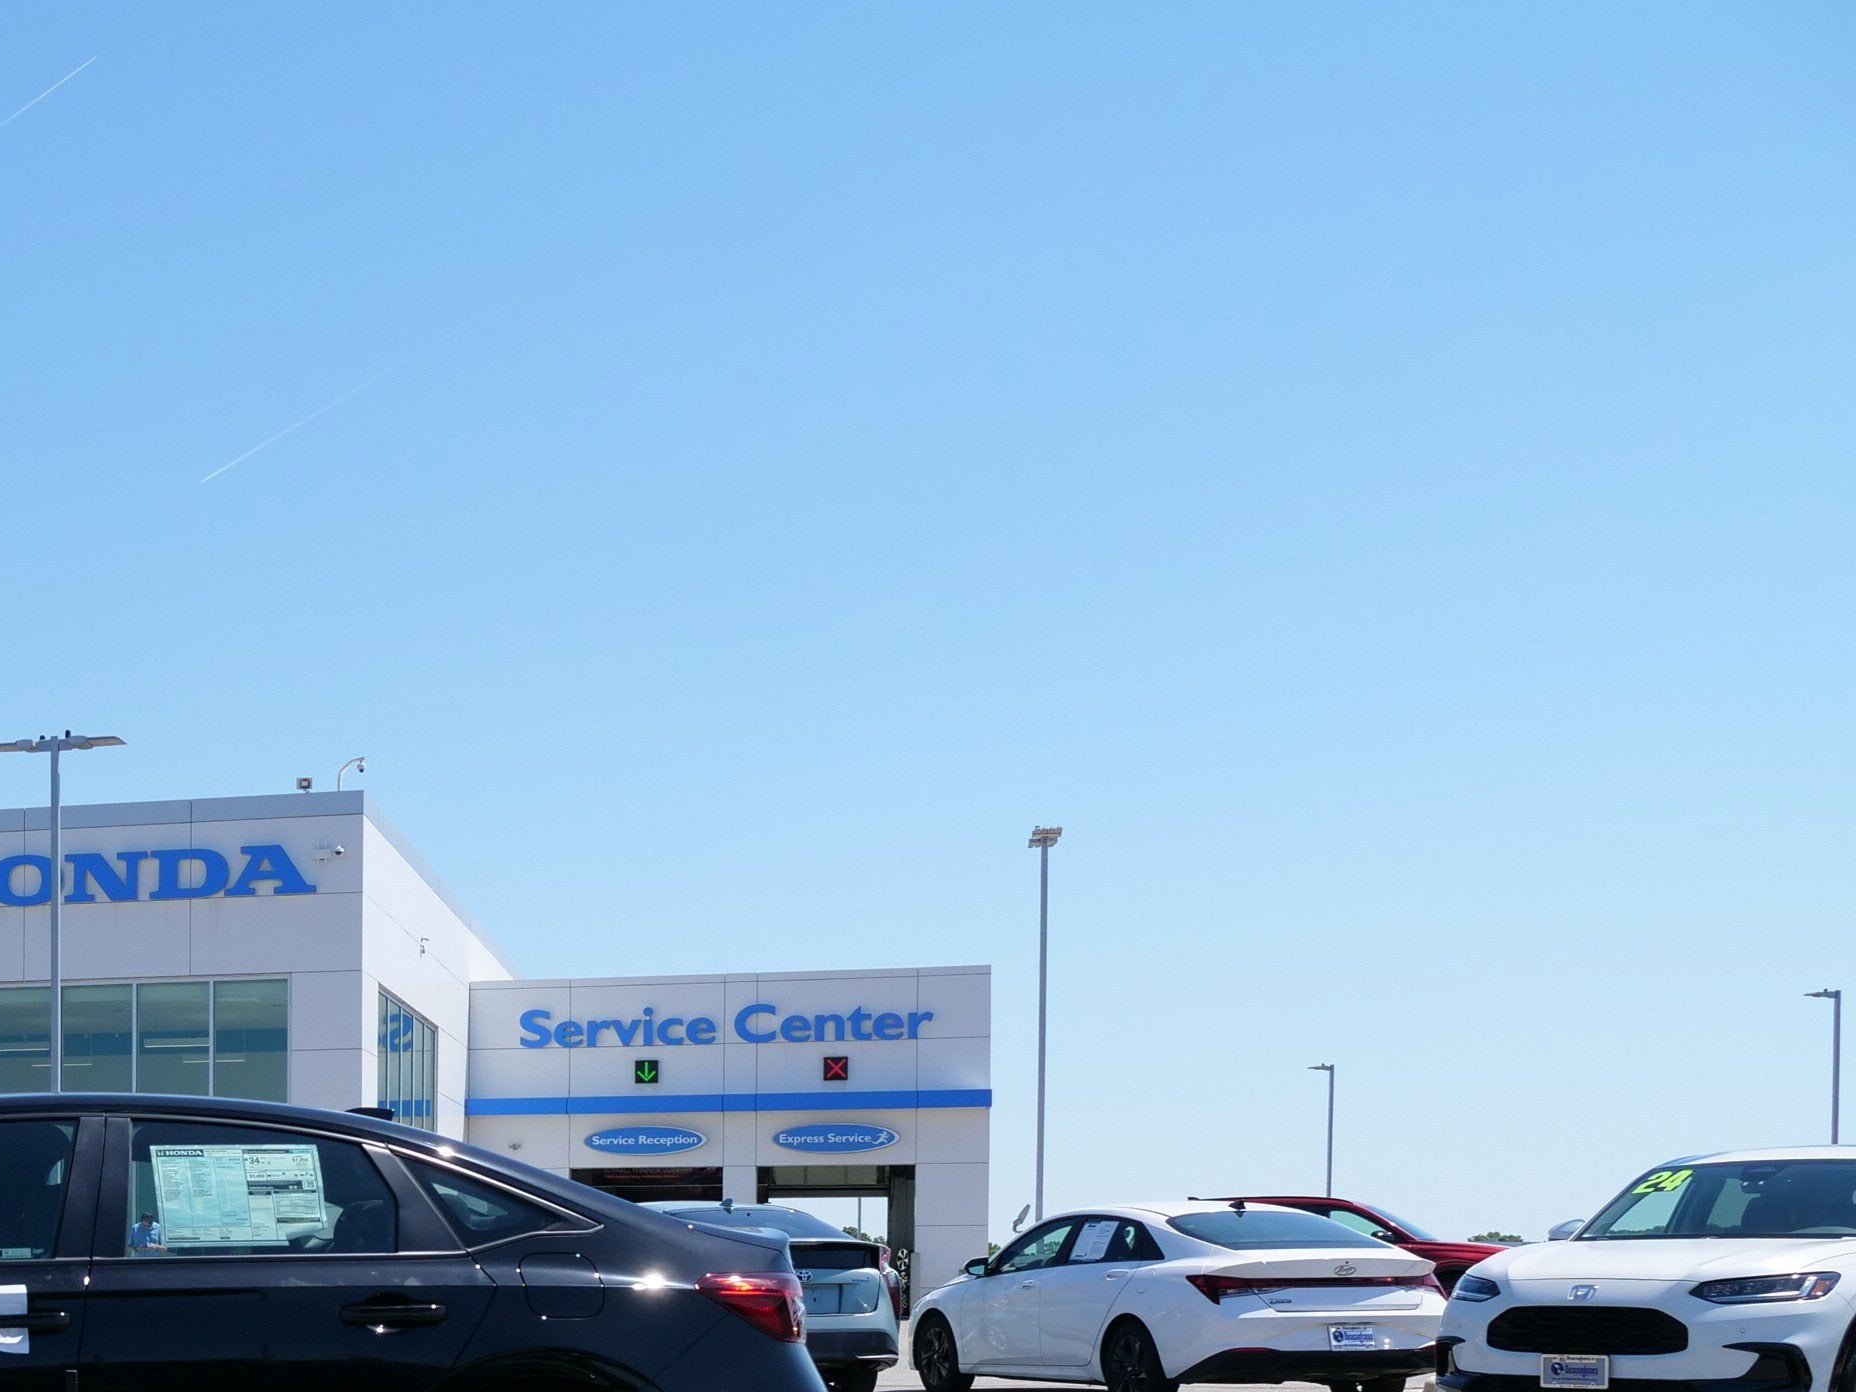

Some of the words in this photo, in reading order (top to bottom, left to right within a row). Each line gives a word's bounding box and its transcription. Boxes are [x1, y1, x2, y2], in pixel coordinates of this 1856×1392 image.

[519, 1007, 716, 1048] Service
[734, 1003, 934, 1043] Center
[591, 1135, 635, 1145] Service
[638, 1134, 697, 1146] Reception
[779, 1133, 824, 1145] Express
[827, 1133, 872, 1143] Service
[1632, 1169, 1693, 1194] 24
